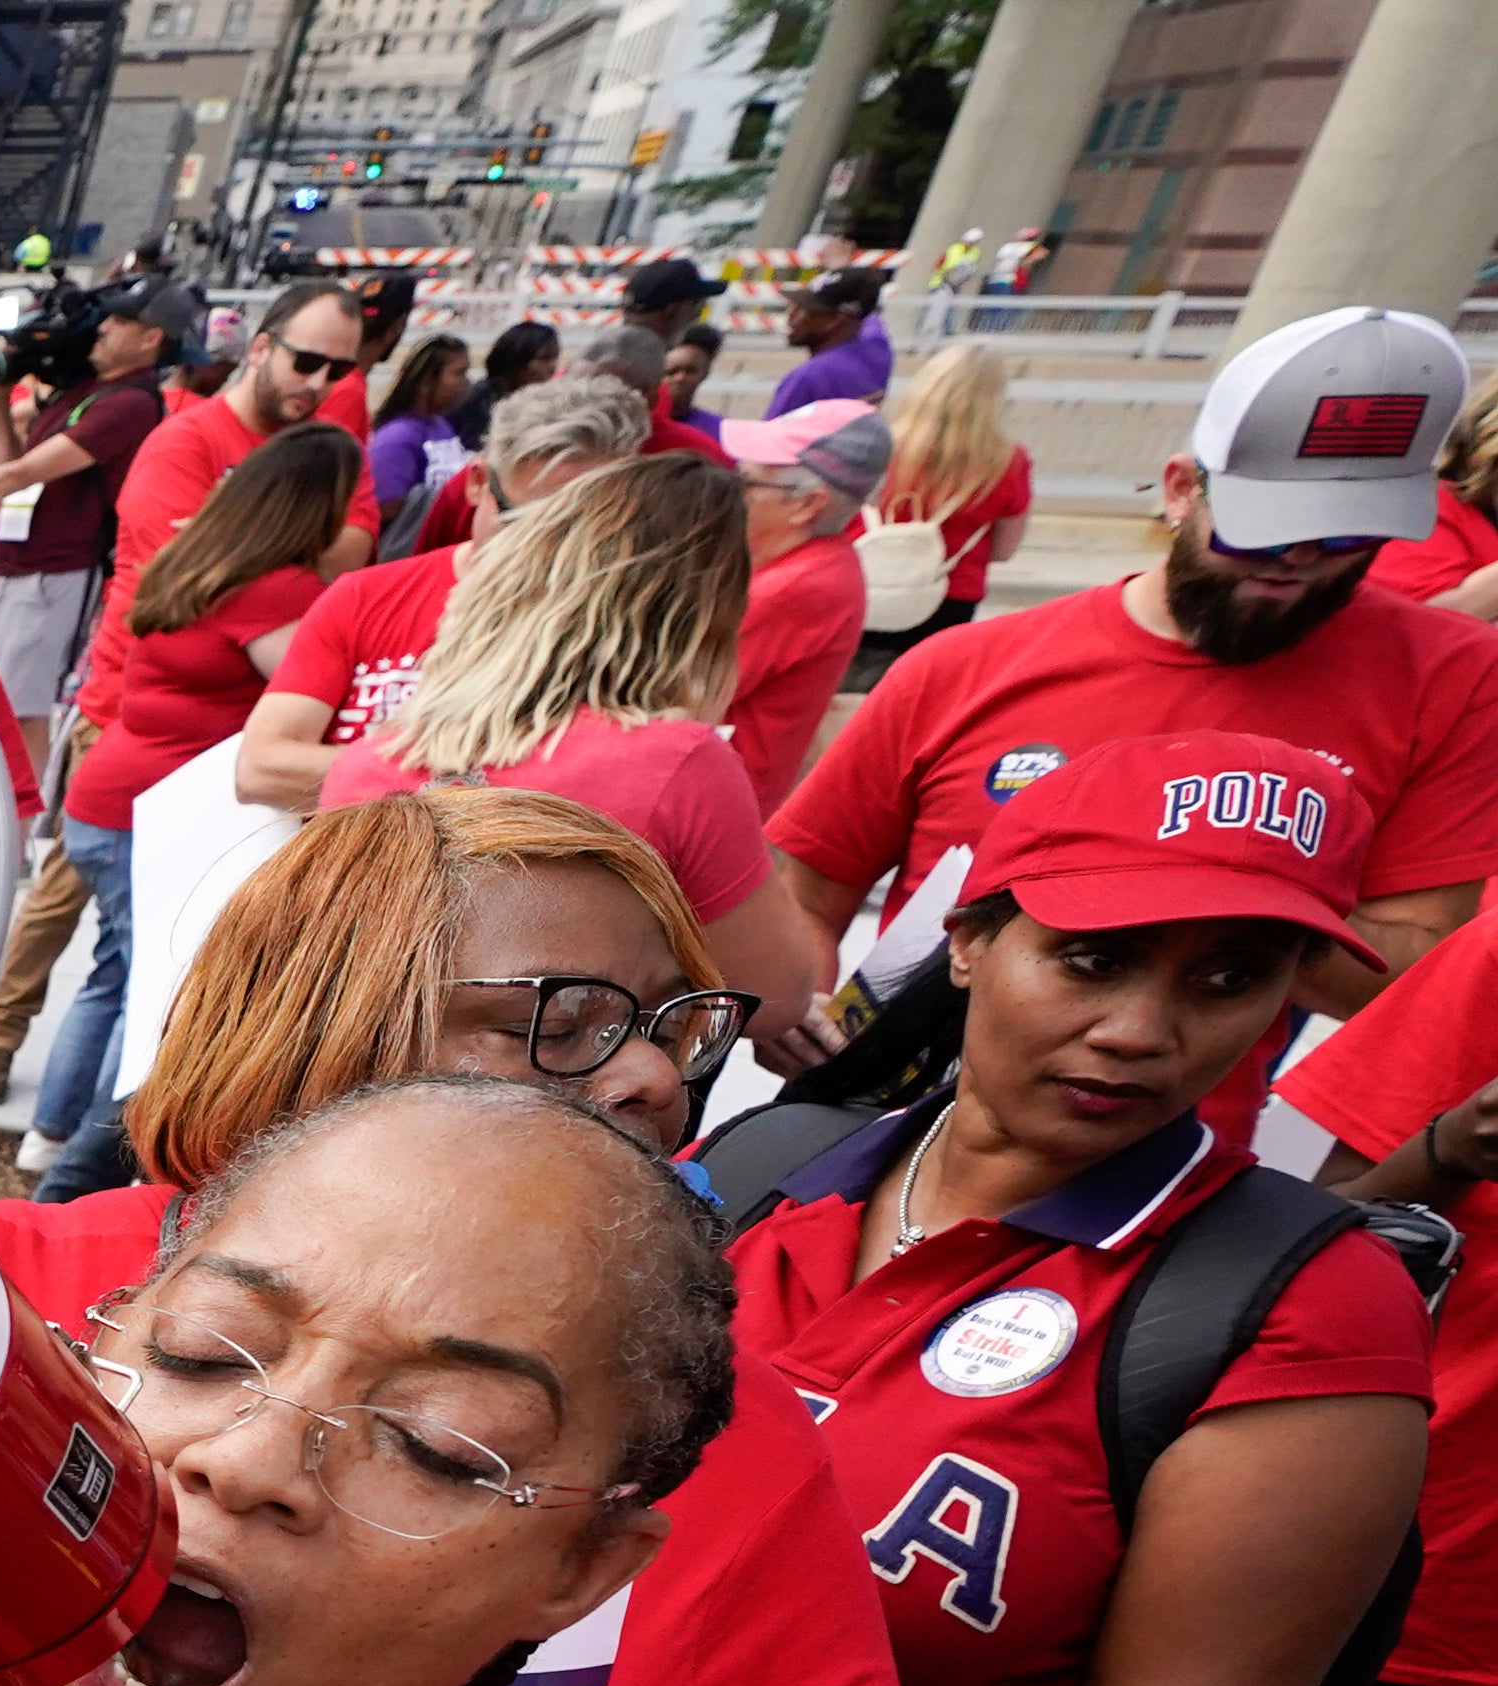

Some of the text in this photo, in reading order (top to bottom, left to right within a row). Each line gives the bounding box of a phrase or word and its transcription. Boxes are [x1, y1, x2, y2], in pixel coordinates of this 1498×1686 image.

[1157, 771, 1327, 858] POLO
[1012, 1303, 1030, 1320] I
[970, 1313, 1047, 1341] Don't Want to
[953, 1348, 974, 1362] But
[957, 1328, 1029, 1359] Strike
